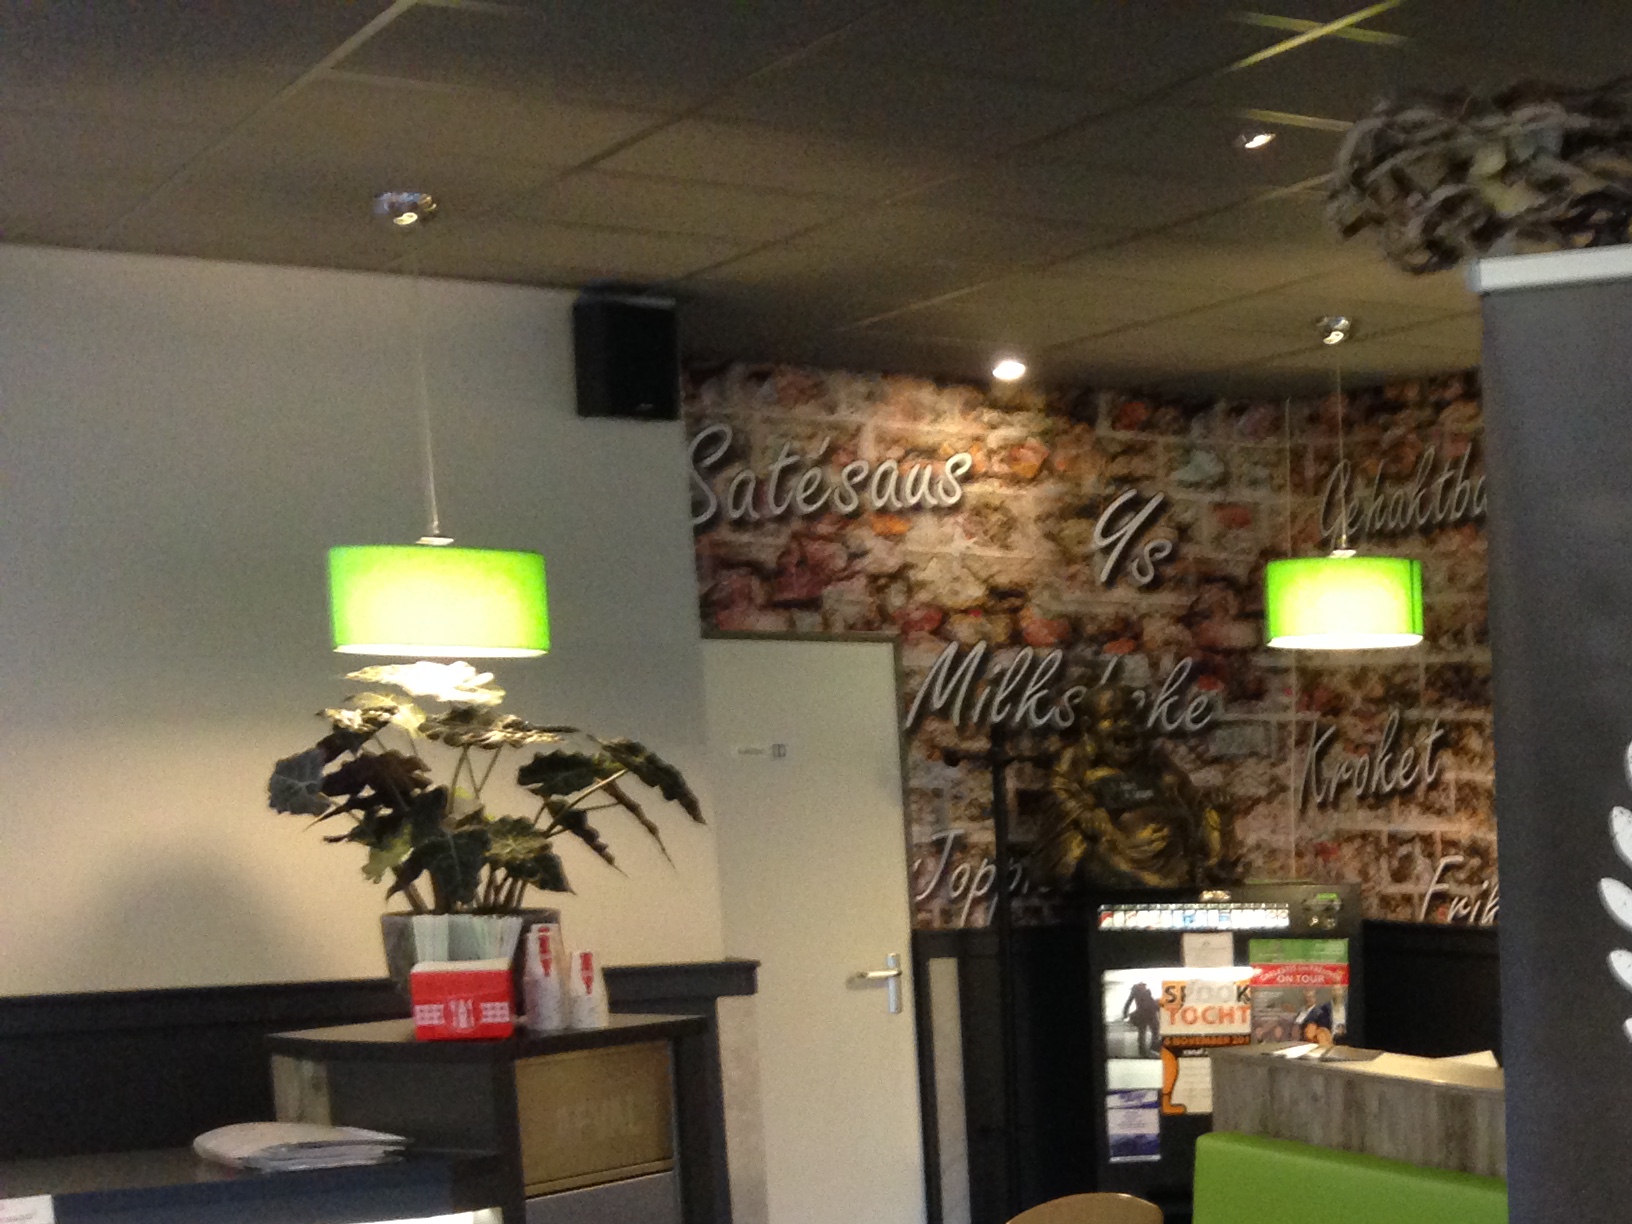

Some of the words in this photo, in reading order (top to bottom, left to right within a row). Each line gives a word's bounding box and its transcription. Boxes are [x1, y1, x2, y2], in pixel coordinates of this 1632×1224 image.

[689, 423, 972, 526] Satésaus
[905, 639, 1212, 732] Milkske
[1300, 707, 1445, 812] Kroket
[1166, 1005, 1252, 1026] TOCHT
